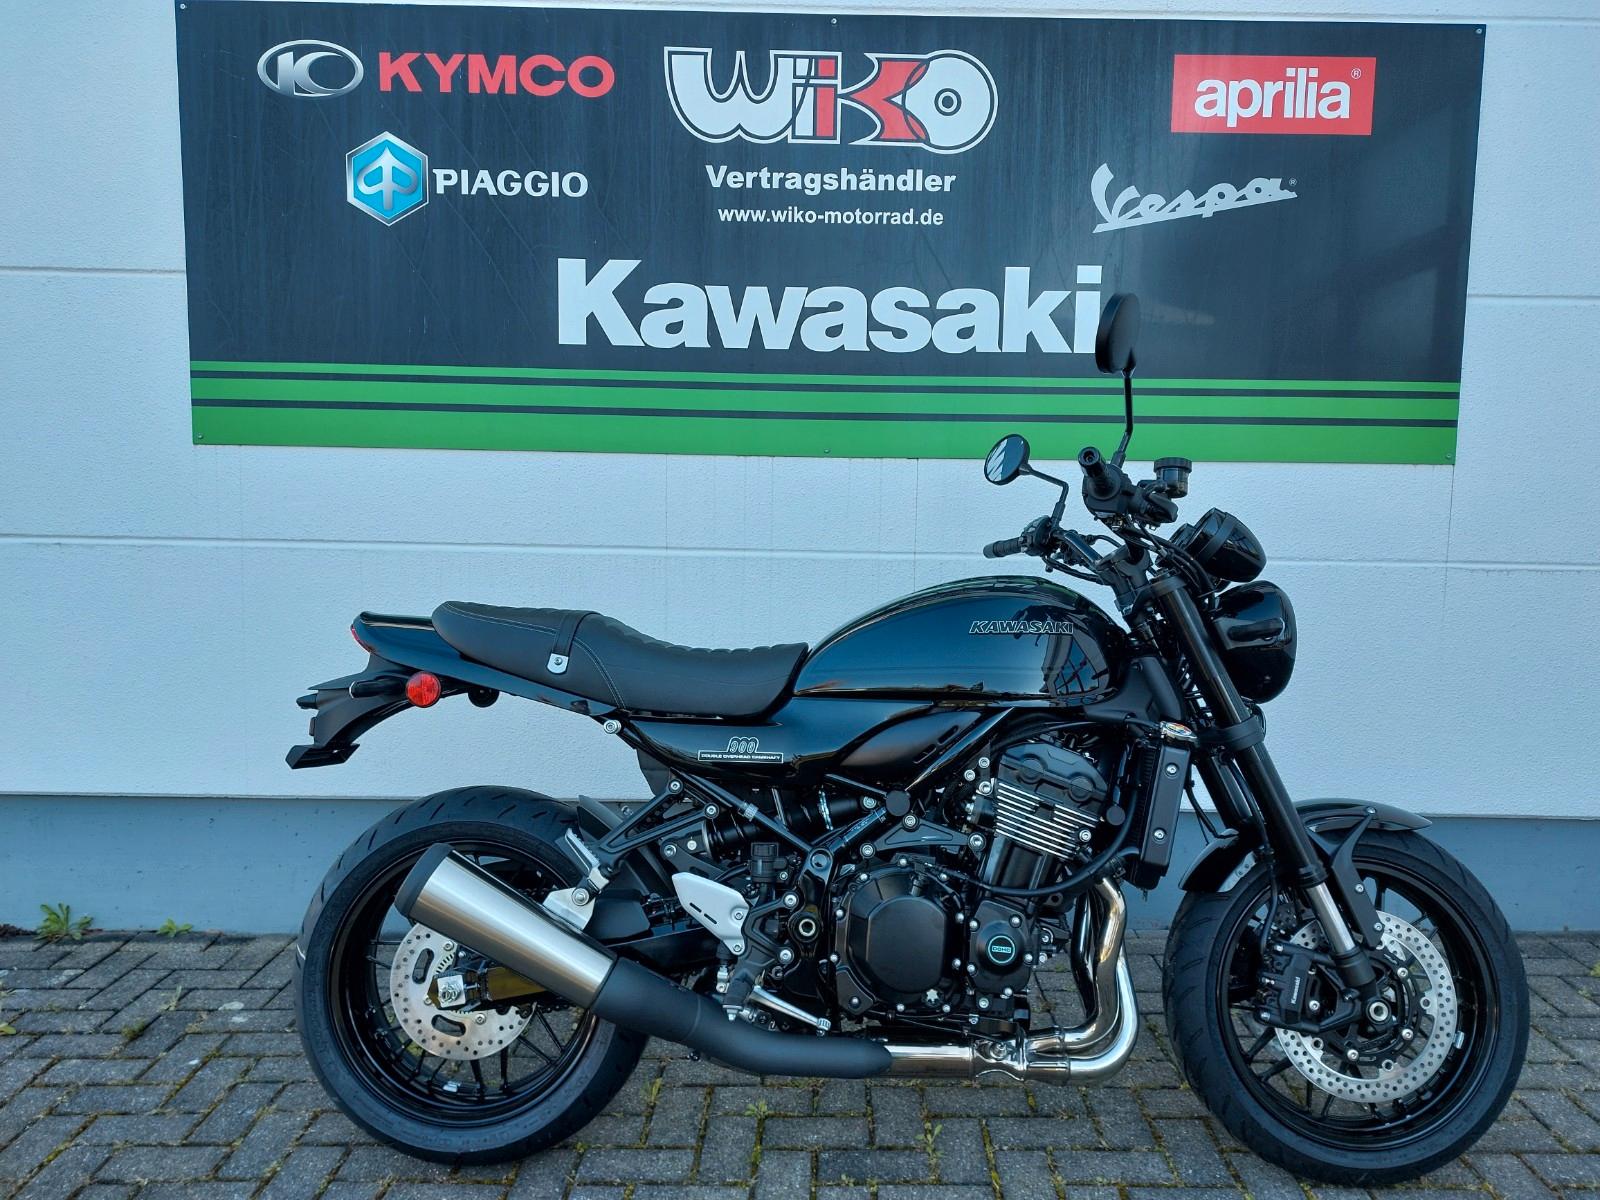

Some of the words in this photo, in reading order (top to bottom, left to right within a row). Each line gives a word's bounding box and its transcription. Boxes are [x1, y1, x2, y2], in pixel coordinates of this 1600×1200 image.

[378, 51, 615, 98] KYMCO
[1194, 67, 1351, 128] aprilia
[432, 168, 589, 198] PIAGGIO
[705, 164, 956, 195] Vertragshändler
[1090, 162, 1298, 234] Vespa
[718, 206, 944, 226] www.wiko-motorrad.de
[557, 257, 1102, 354] Kawasaki
[968, 620, 1074, 634] KAWASAKI
[730, 740, 756, 753] 900
